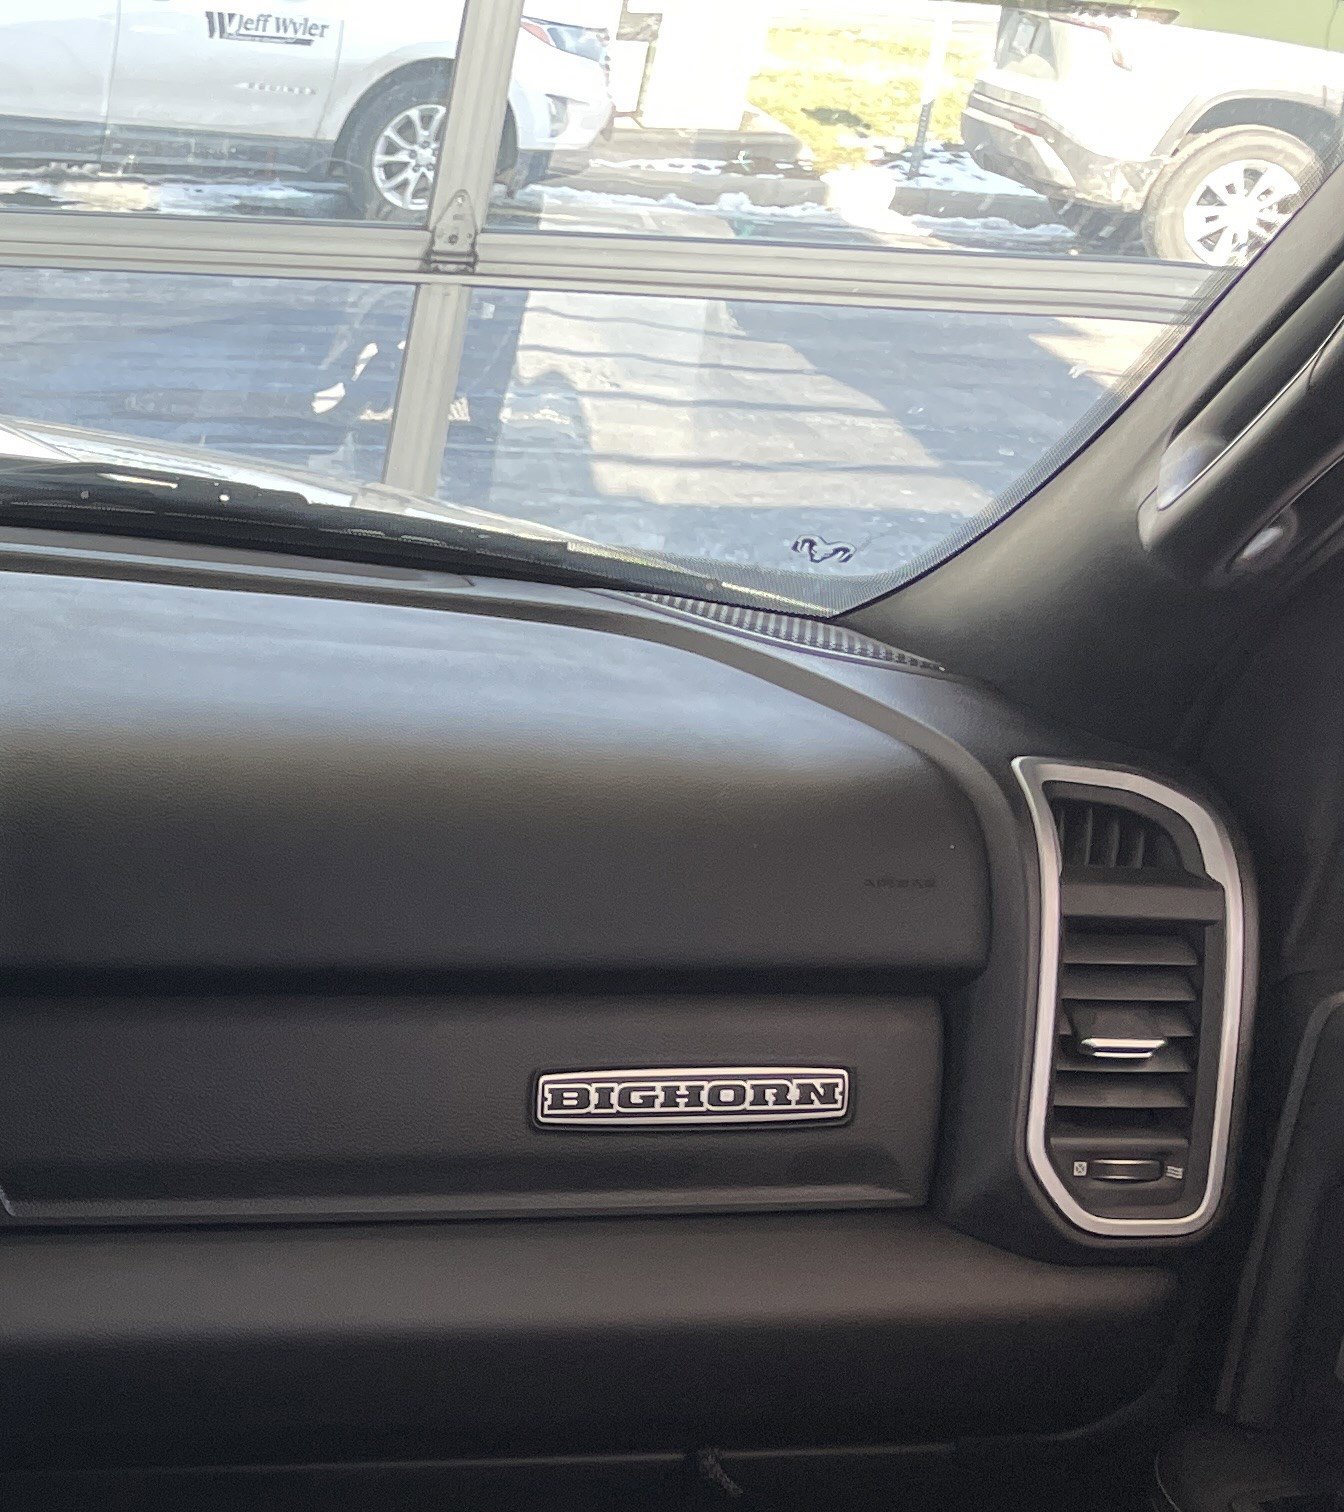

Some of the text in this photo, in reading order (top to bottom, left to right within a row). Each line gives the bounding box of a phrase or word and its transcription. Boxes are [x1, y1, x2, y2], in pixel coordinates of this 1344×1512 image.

[237, 13, 272, 33] Jeff
[275, 17, 330, 38] Wyler
[543, 1078, 844, 1115] BIGHORN
